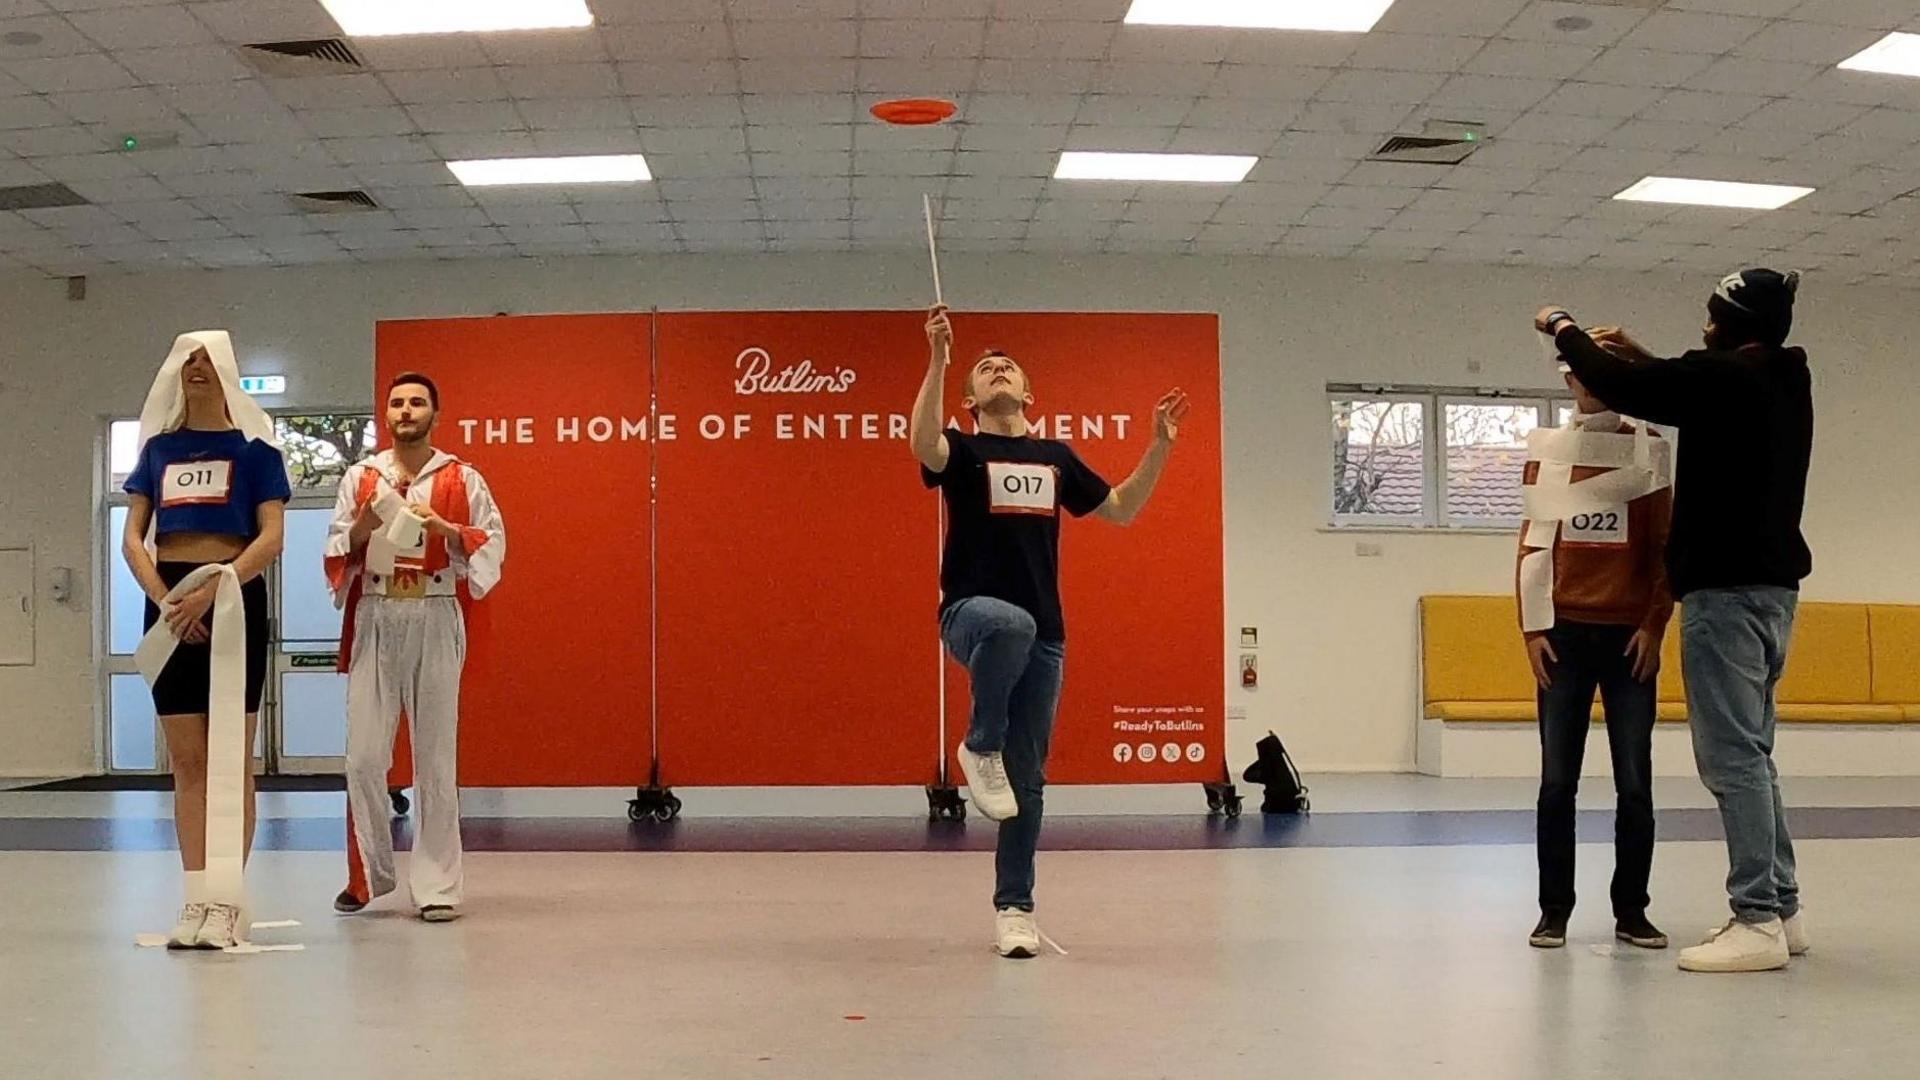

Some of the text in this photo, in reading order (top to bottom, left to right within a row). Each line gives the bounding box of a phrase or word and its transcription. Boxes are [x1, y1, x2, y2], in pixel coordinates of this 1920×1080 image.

[735, 347, 857, 395] Butlin's
[458, 418, 534, 444] THE
[557, 415, 677, 442] HOME
[699, 414, 751, 439] OF
[177, 470, 212, 487] 011
[1003, 475, 1043, 494] 017
[1571, 512, 1618, 531] 022
